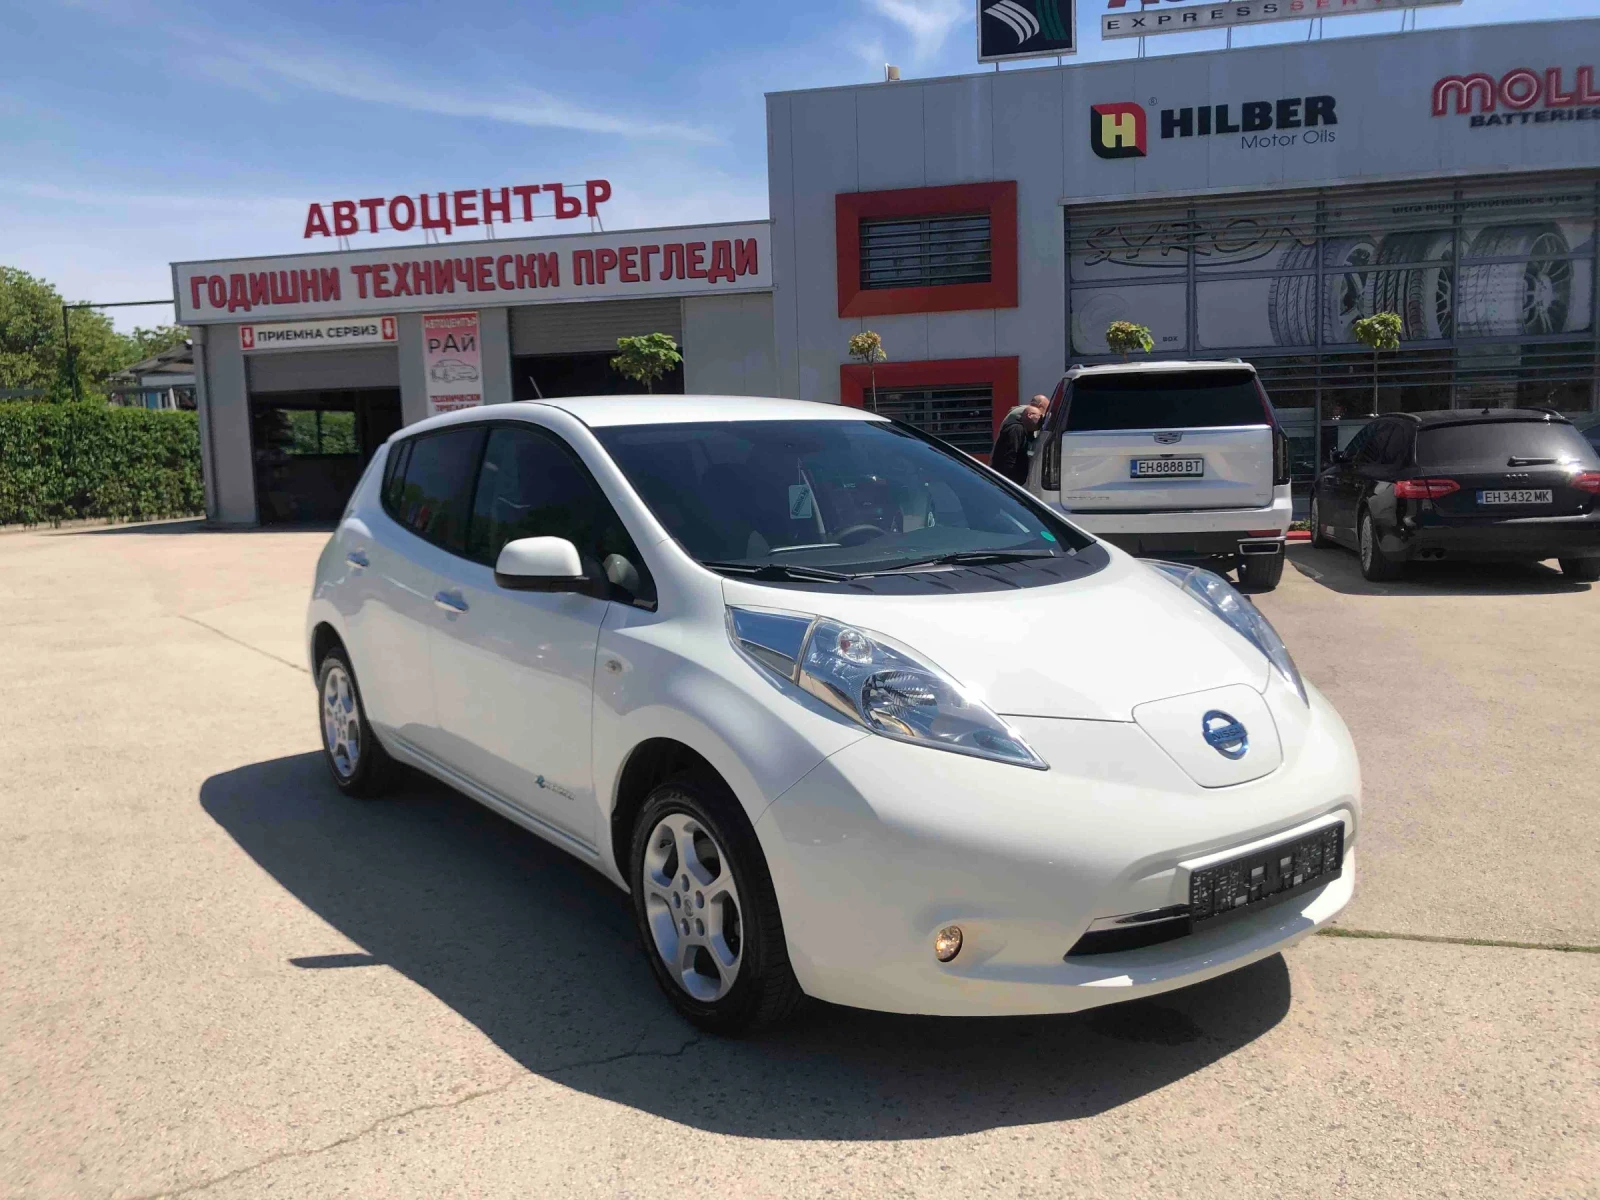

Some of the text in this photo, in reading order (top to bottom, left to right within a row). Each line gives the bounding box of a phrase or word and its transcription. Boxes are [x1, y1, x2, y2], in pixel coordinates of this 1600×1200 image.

[1107, 3, 1278, 30] EXPRESS
[1160, 95, 1338, 139] HILBER
[1470, 108, 1600, 127] BATTERIES
[1241, 129, 1336, 149] Motor Oils
[304, 179, 612, 239] АВТОЦЕНТЪР
[190, 238, 758, 313] ГОДИШНИ ТЕХНИЧЕСКИ ПРЕГЛЕДИ
[258, 324, 378, 342] ПРИЕМНА СЕРВИЗ
[428, 333, 476, 354] РАЙ
[1156, 460, 1184, 473] 8888
[1185, 460, 1201, 472] BT
[1485, 491, 1550, 503] EH 3432 MK
